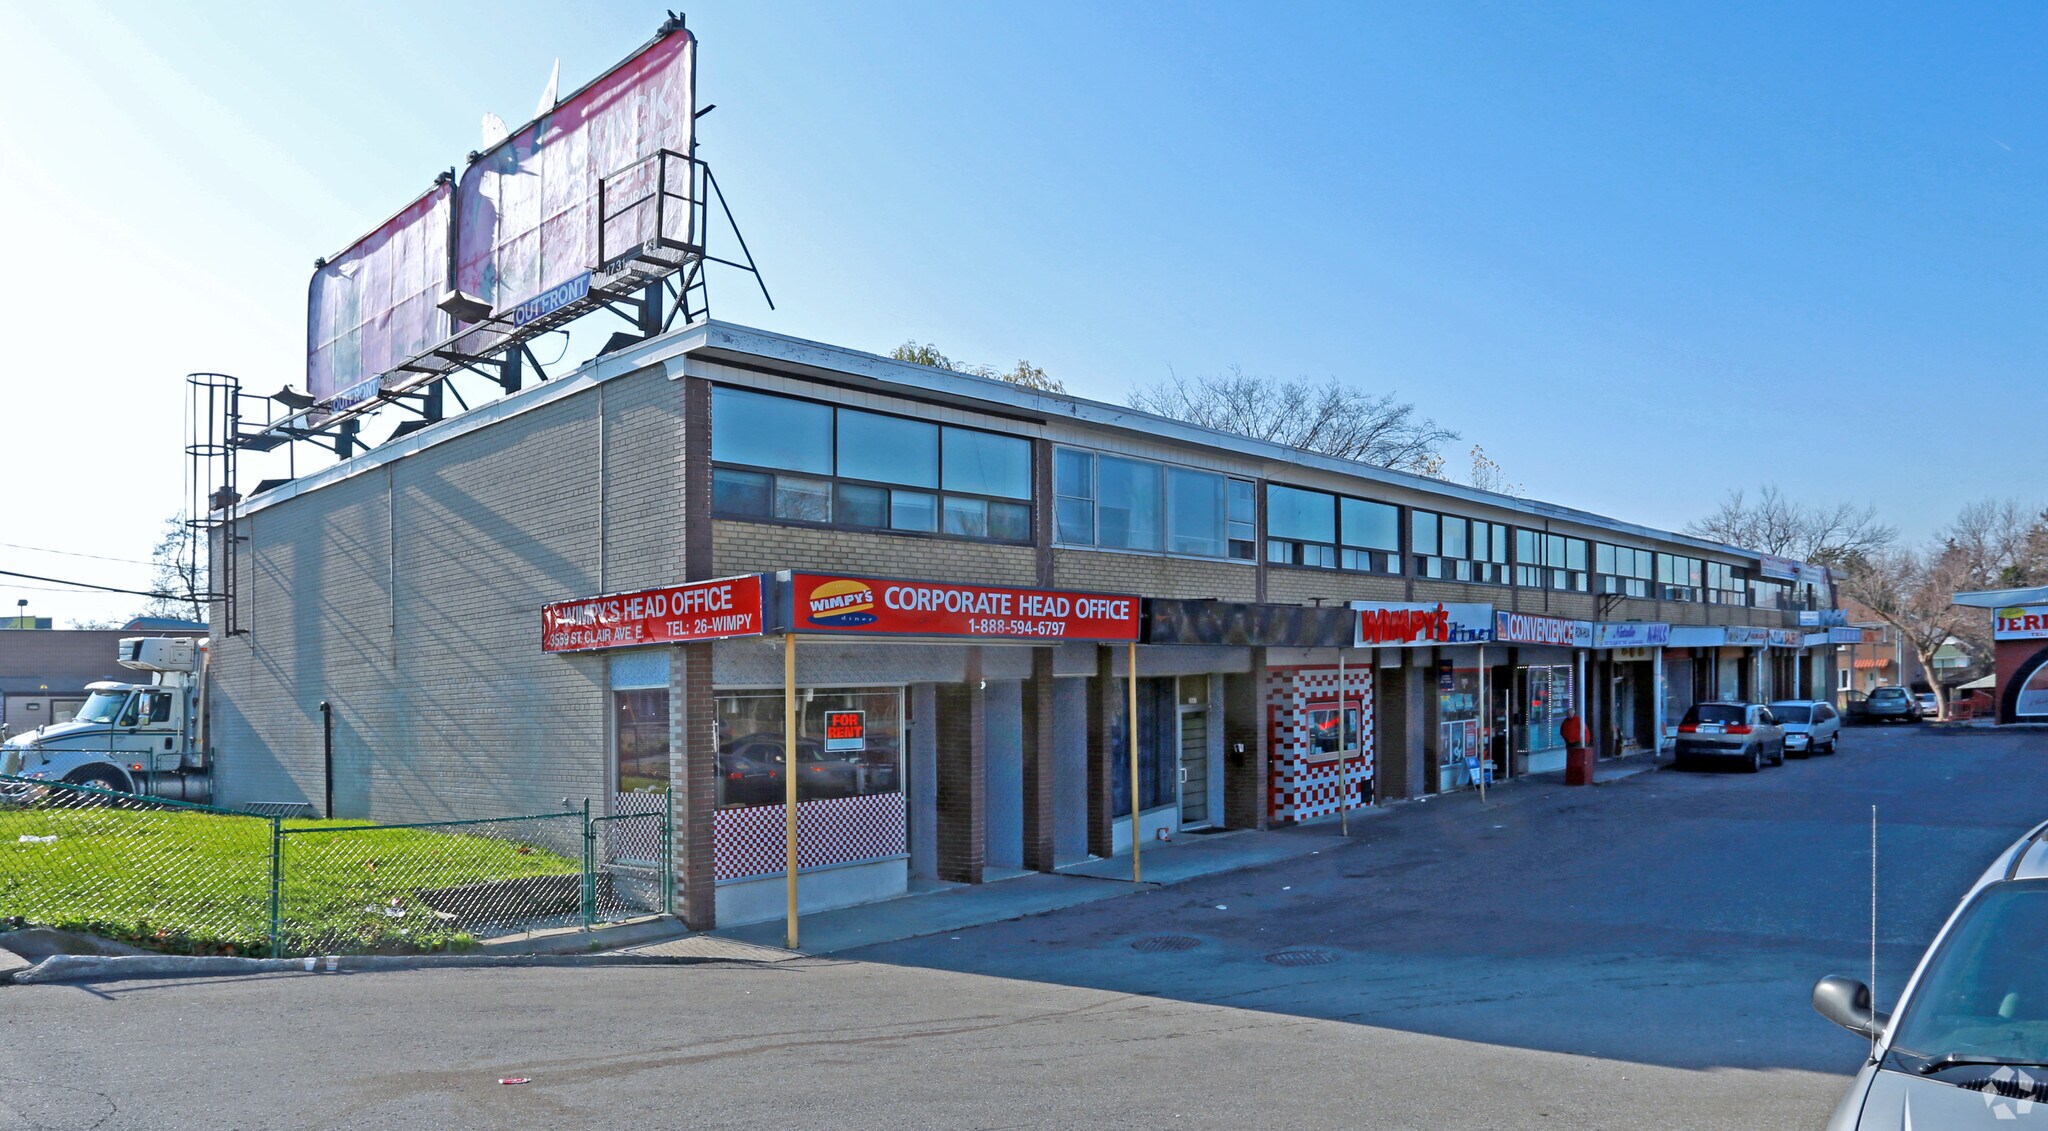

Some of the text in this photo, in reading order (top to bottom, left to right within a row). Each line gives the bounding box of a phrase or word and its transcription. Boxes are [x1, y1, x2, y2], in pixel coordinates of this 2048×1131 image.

[606, 258, 626, 277] 1731
[515, 274, 589, 325] OUTFRONT
[333, 379, 378, 411] OUTFRONT
[562, 585, 733, 627] WIMPY'S HEAD OFFICE
[809, 589, 873, 612] WIMPY'S
[884, 586, 1130, 620] CORPORATE HEAD OFFICE
[550, 631, 569, 647] 3559
[584, 628, 611, 644] CLAIR
[613, 625, 633, 641] AVE.
[635, 624, 644, 639] E.
[666, 613, 752, 637] TEL: 26-WIMPY
[968, 618, 1066, 636] 1-888-594-6797
[1448, 622, 1494, 642] diner
[1510, 614, 1573, 644] CONVENIENCE
[1646, 625, 1667, 643] NAILS
[832, 714, 859, 726] FOR
[827, 725, 863, 739] RENT
